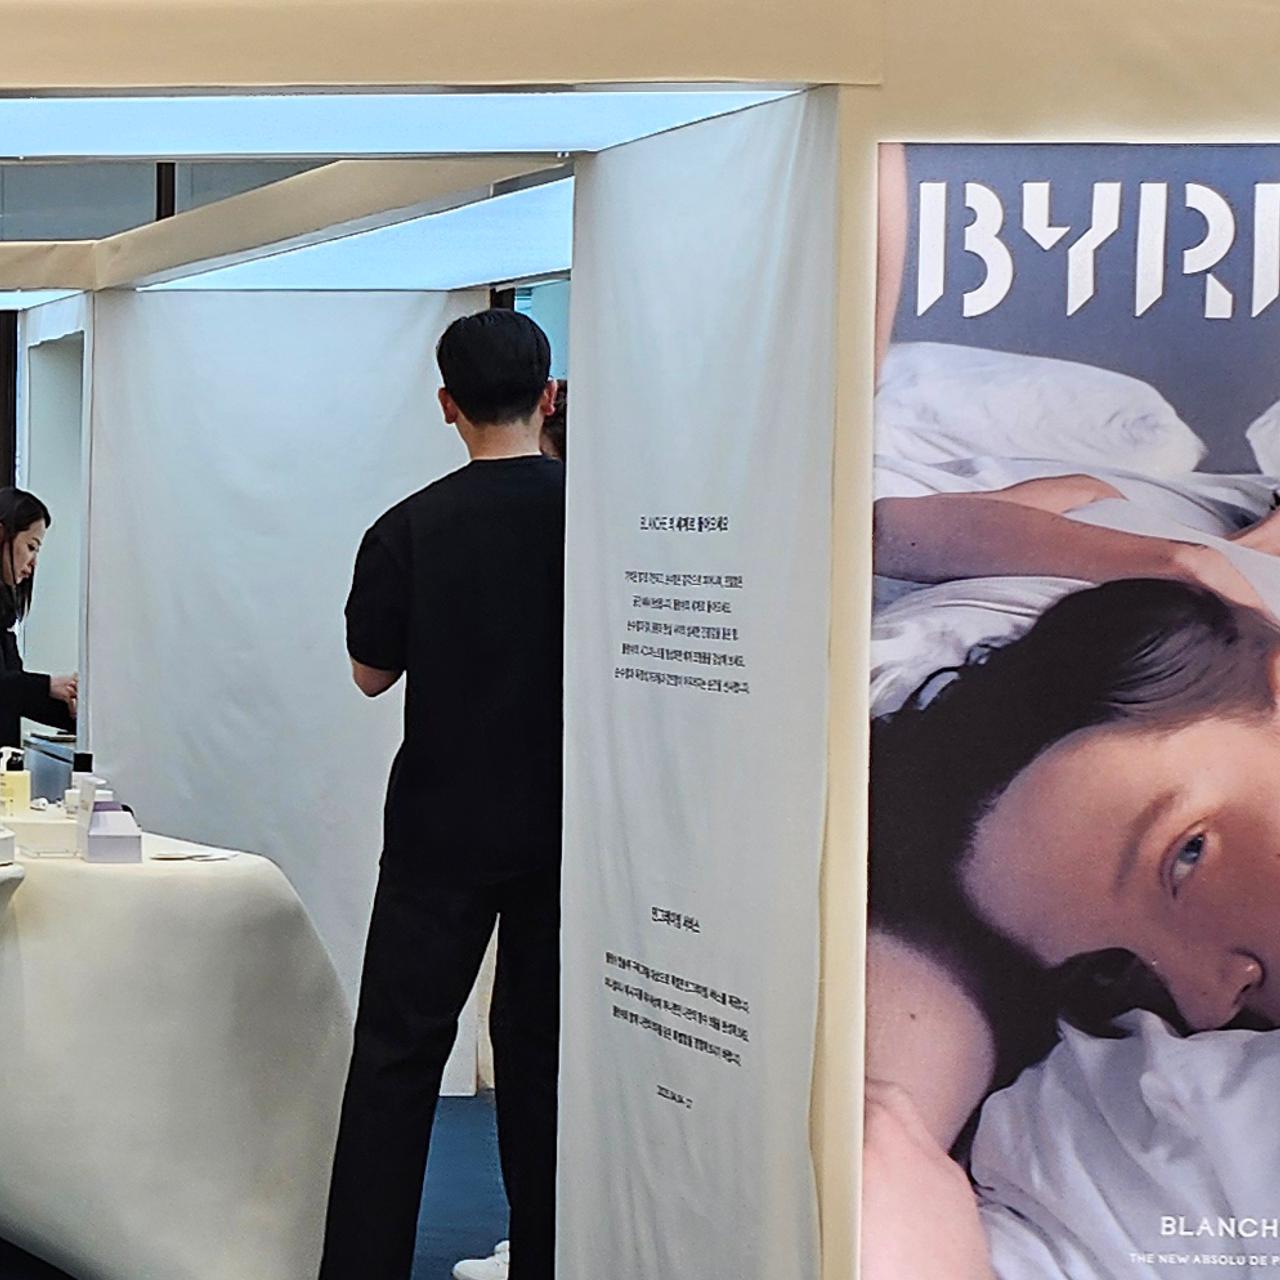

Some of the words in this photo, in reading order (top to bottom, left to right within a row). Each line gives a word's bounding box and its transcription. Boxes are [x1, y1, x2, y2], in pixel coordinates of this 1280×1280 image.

[1160, 1216, 1279, 1238] BLANCH
[1130, 1253, 1154, 1264] THE
[1159, 1254, 1189, 1264] NEW
[1193, 1255, 1245, 1266] ABSOLU
[1249, 1255, 1267, 1266] DE
